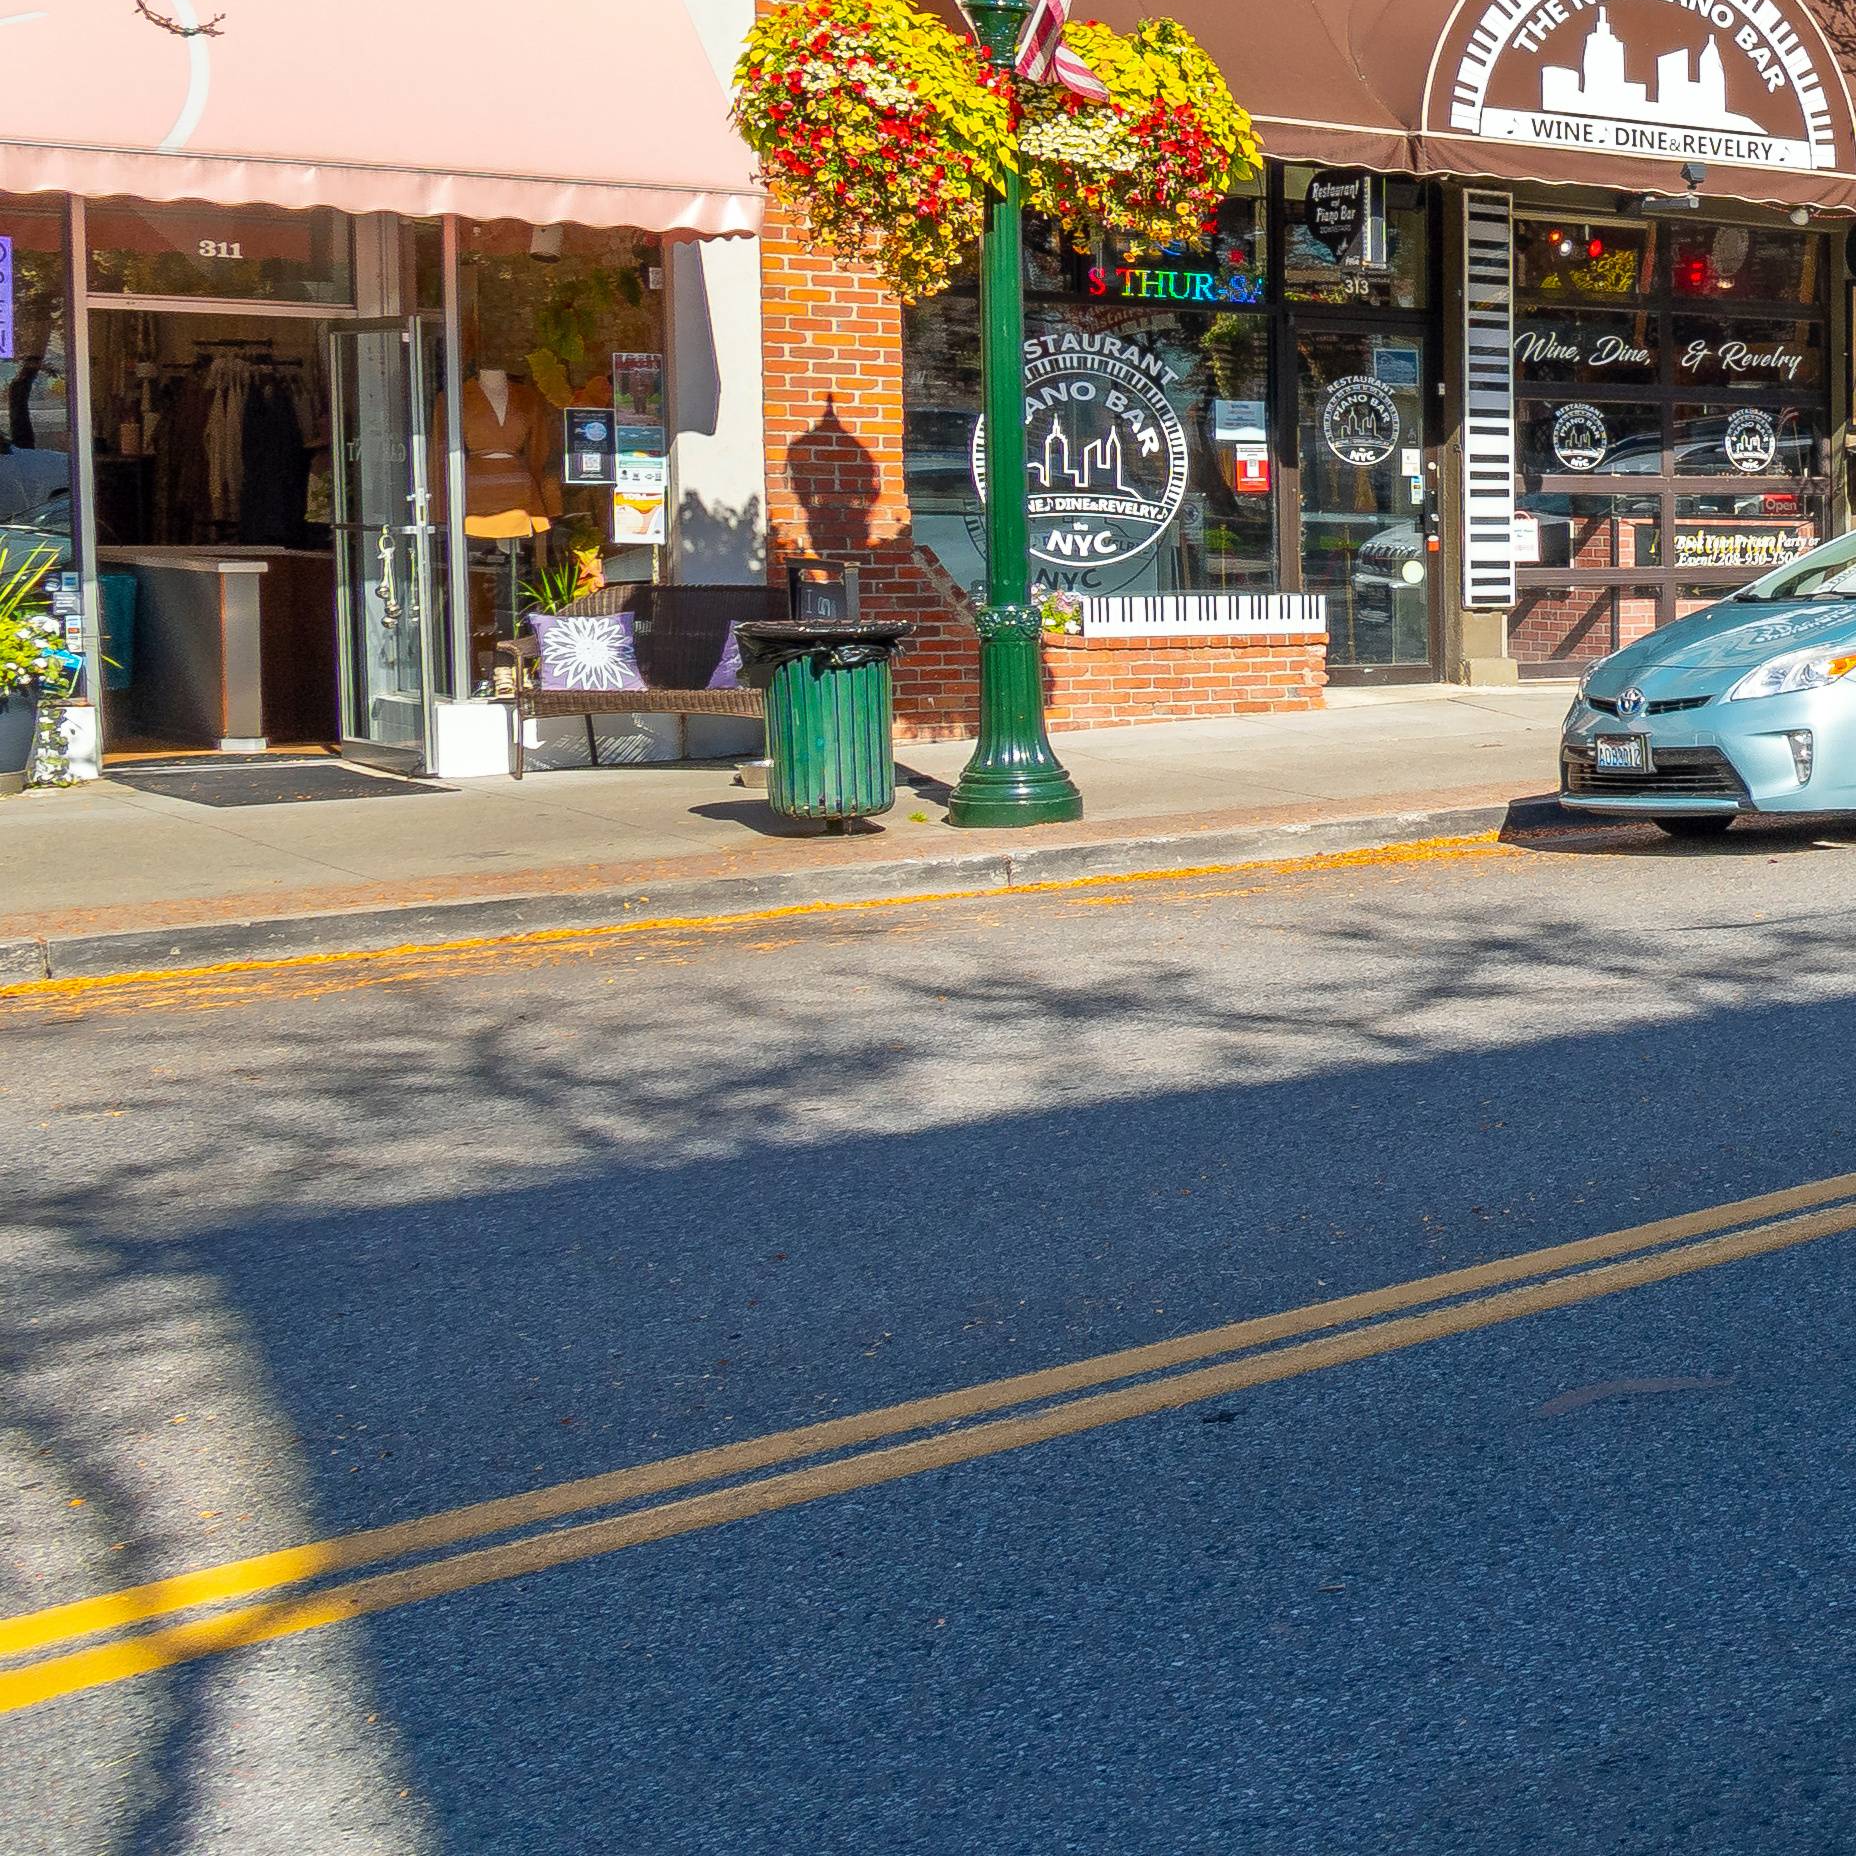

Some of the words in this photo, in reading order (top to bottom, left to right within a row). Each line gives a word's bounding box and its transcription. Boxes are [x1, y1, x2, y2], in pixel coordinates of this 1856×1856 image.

[1733, 24, 1786, 94] BAR
[1531, 117, 1593, 143] WINE
[1341, 205, 1356, 220] Bar
[199, 239, 243, 259] 311
[1345, 278, 1369, 294] 313
[1024, 333, 1179, 386] STAURANT
[1514, 331, 1581, 363] Wine,
[1588, 335, 1652, 366] Dine,
[1718, 341, 1803, 380] Revelry
[1327, 375, 1396, 396] RESTAURANT
[1025, 381, 1096, 424] ANO
[1106, 389, 1160, 457] BAR
[1333, 394, 1367, 421] PIANO
[1370, 396, 1391, 423] BAR
[1349, 449, 1376, 462] NYC
[1765, 498, 1797, 512] Open
[1046, 529, 1117, 557] NYC
